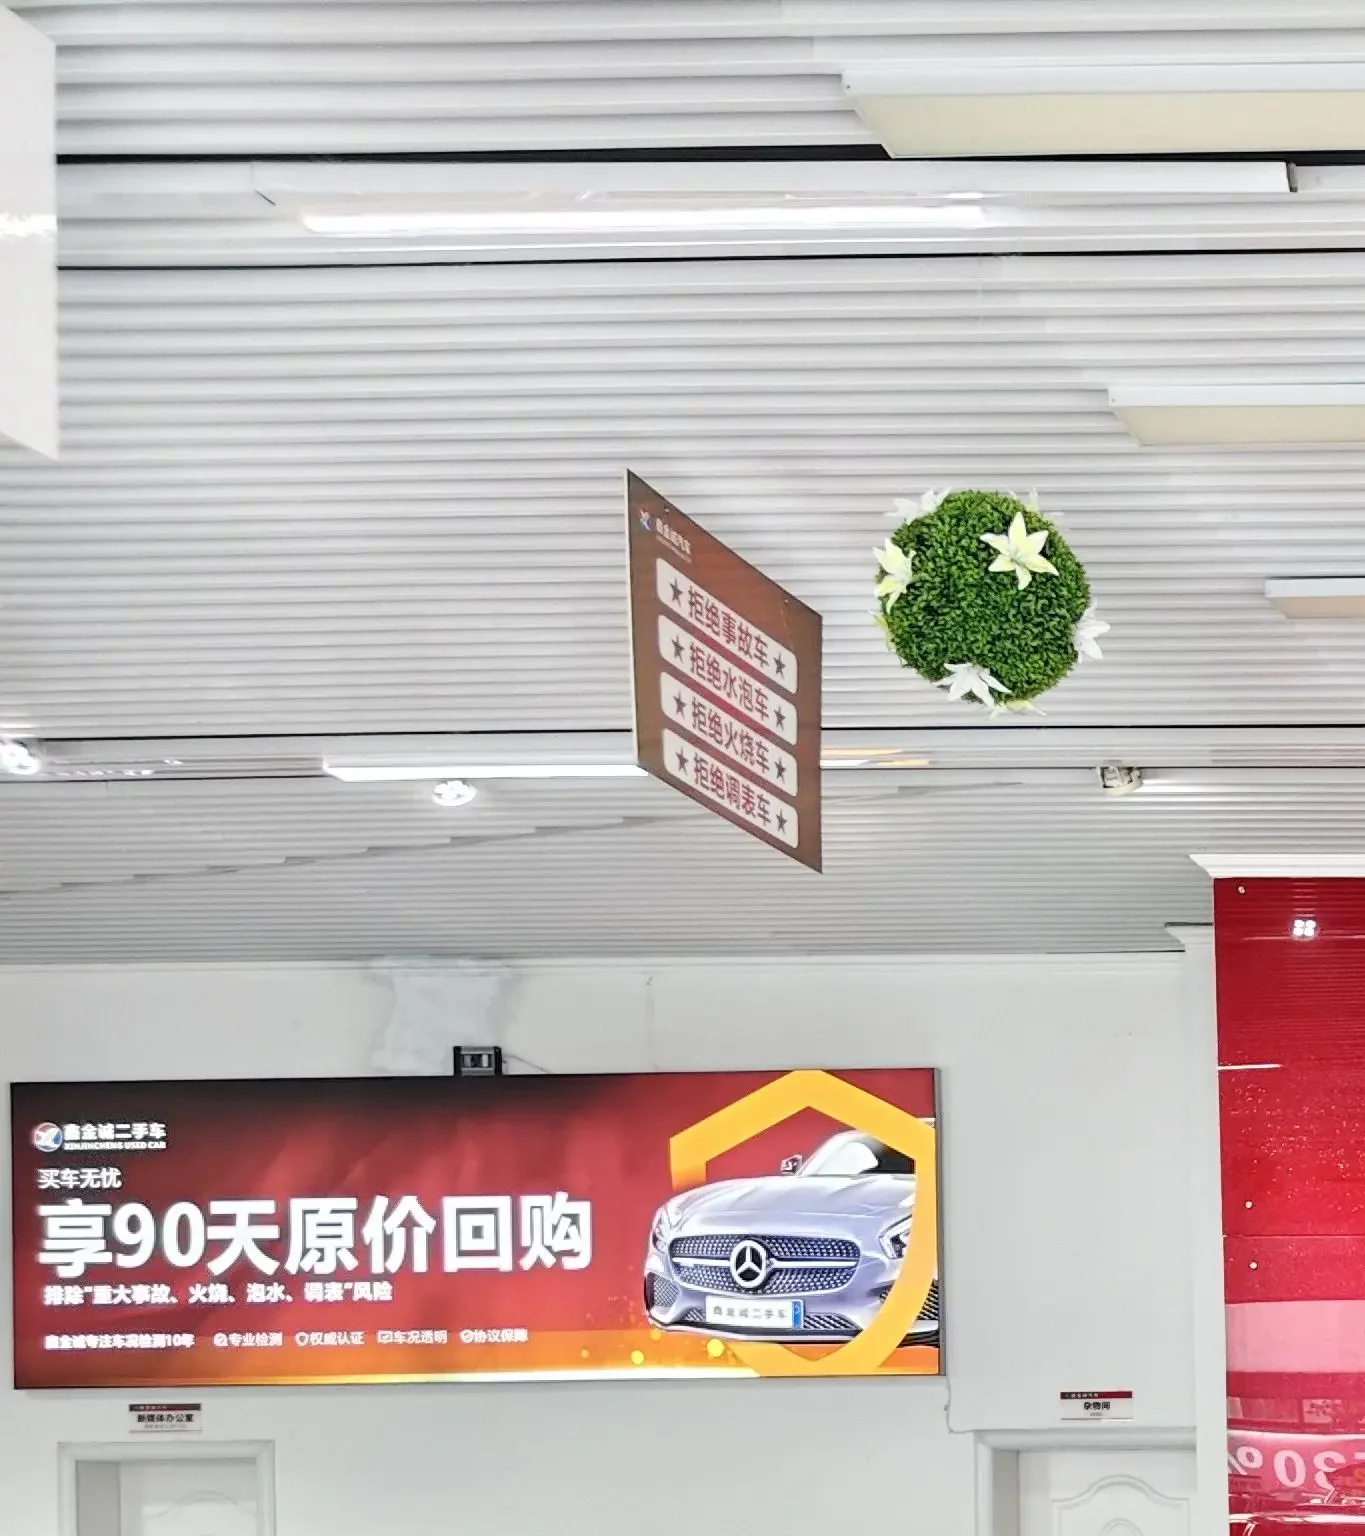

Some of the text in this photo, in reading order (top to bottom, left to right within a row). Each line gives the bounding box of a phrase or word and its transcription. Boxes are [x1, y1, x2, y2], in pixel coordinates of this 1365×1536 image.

[688, 585, 769, 669] 拒绝事故车
[688, 640, 770, 721] 拒绝水泡车
[690, 696, 770, 774] 拒绝火烧车
[692, 755, 772, 827] 拒绝调表车
[37, 1168, 122, 1190] 买车无忧
[36, 1193, 594, 1279] 享90天原价回购
[229, 1328, 529, 1347] 专业检测 权威认证 车况透明 协议保障
